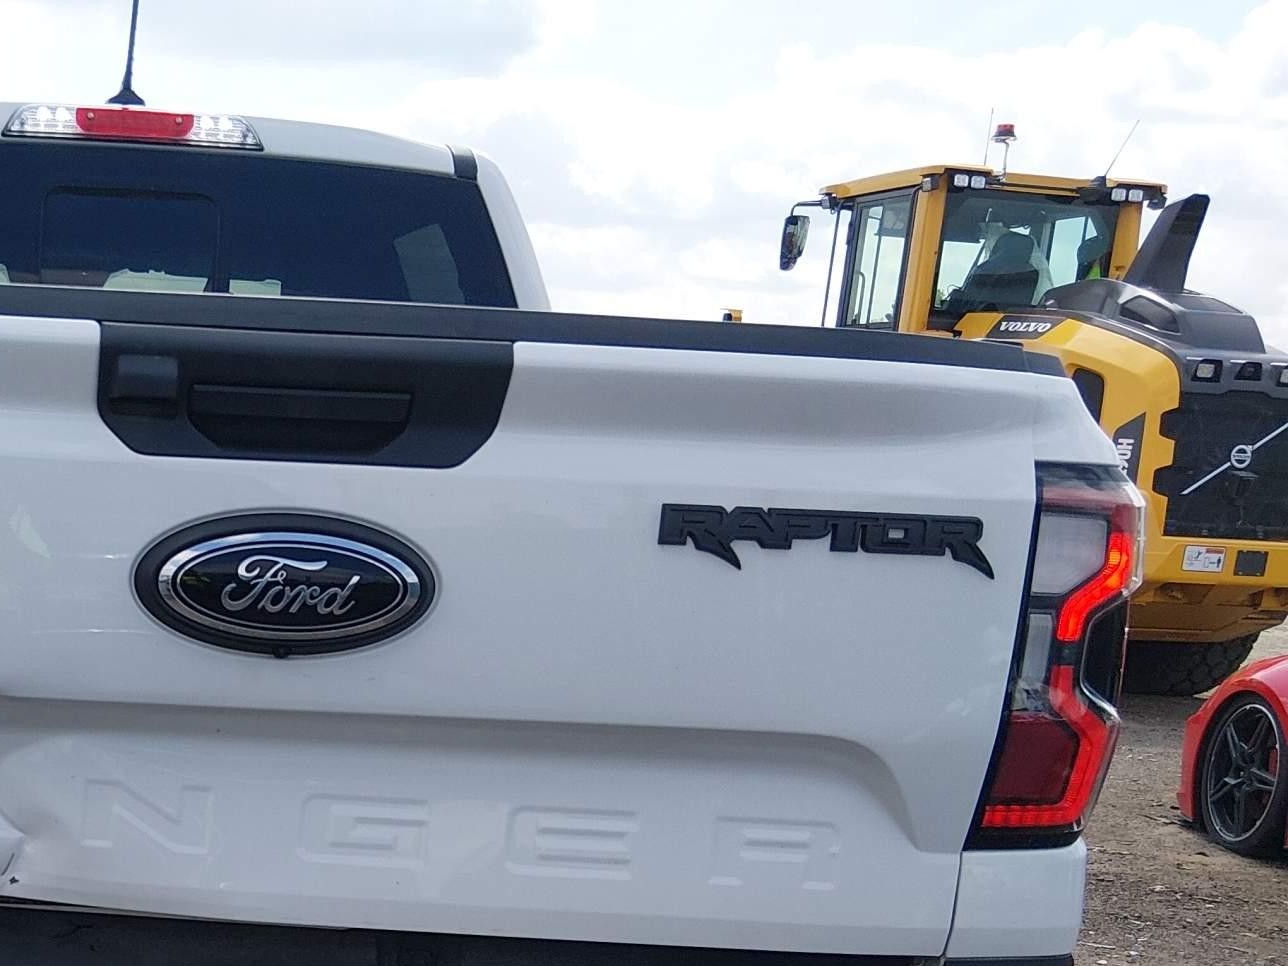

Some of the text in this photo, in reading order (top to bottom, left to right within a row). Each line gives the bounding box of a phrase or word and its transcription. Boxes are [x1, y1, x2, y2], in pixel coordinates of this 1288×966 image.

[999, 321, 1052, 333] VOLVO
[658, 503, 995, 580] RAPTOR
[221, 555, 361, 615] Ford
